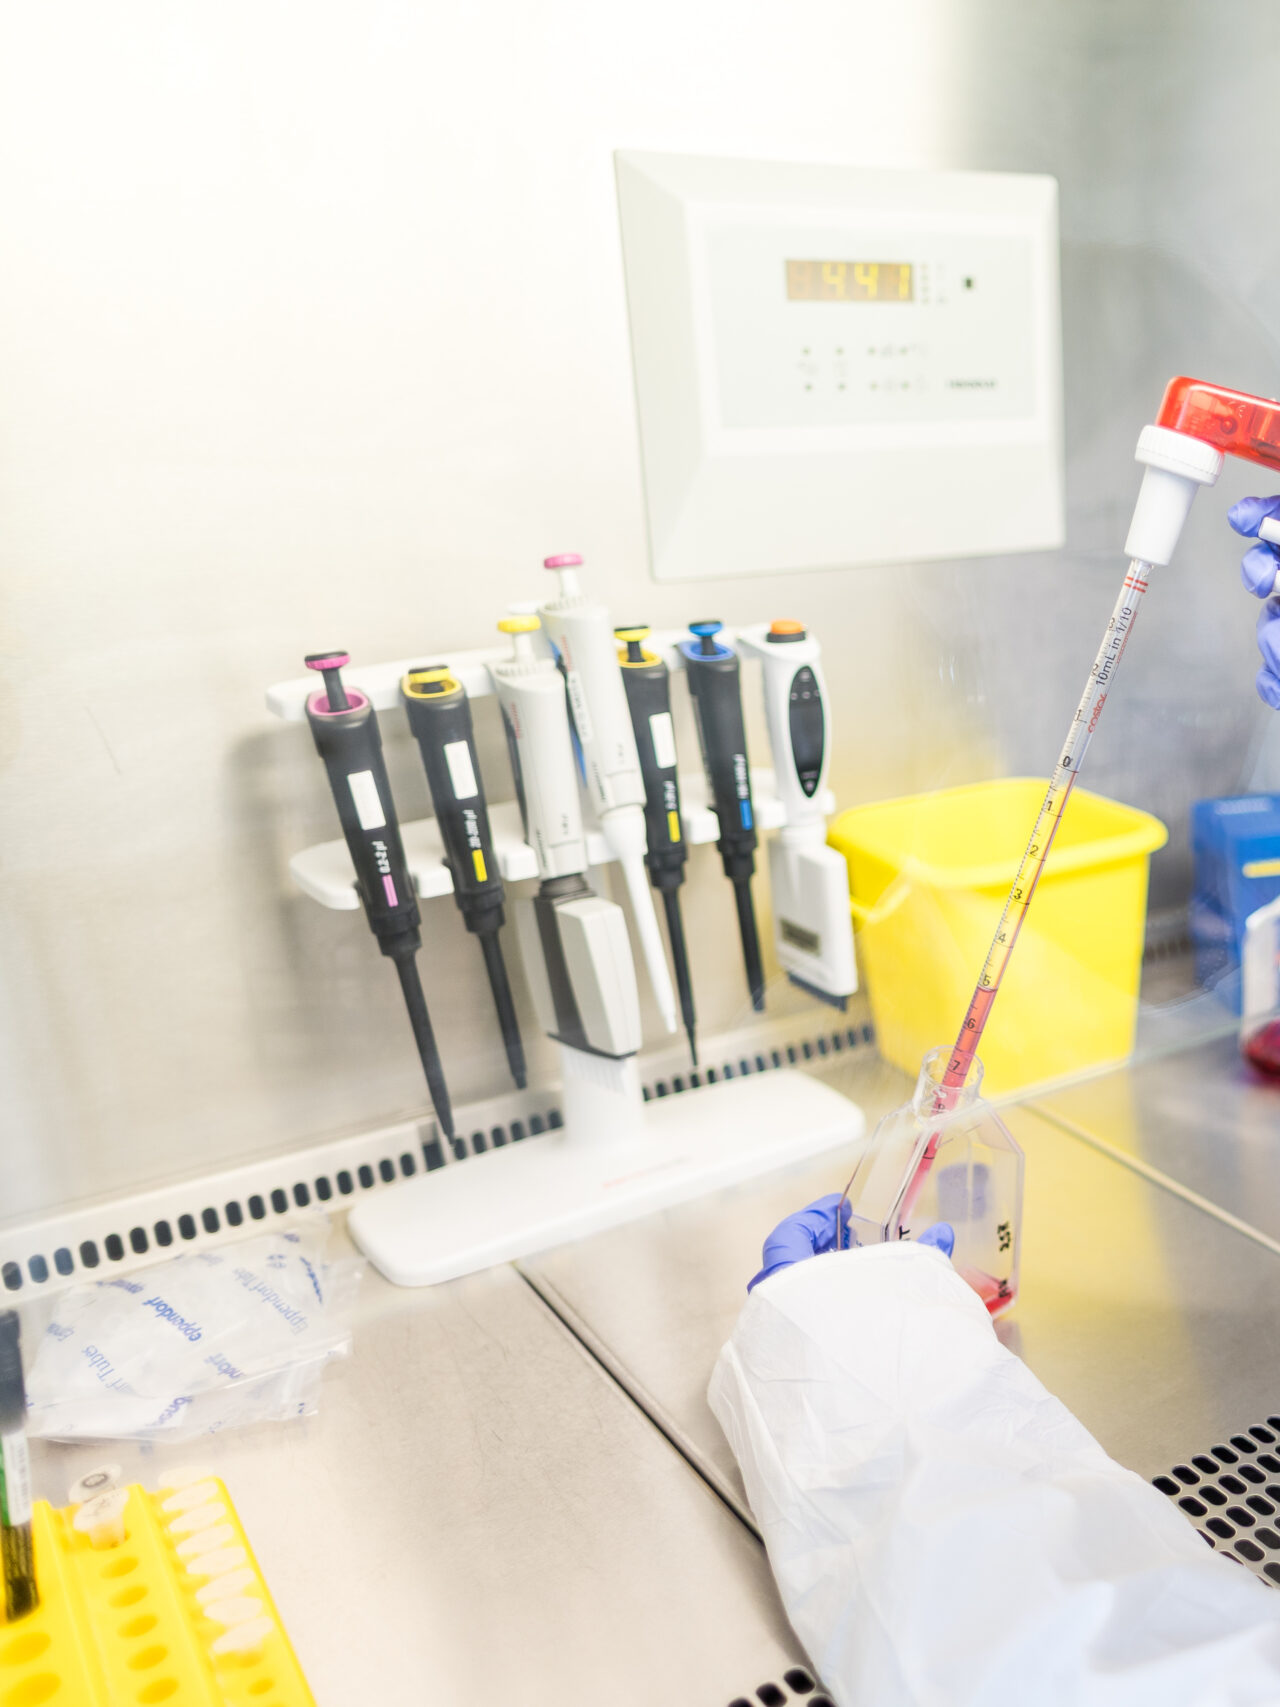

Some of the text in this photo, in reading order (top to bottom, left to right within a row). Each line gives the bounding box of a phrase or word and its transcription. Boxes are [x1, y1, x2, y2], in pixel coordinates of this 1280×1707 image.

[1095, 653, 1117, 686] 10mL
[1108, 637, 1121, 651] in
[1115, 606, 1133, 634] 1/10
[1062, 755, 1072, 768] 0
[1045, 800, 1053, 812] 1
[1029, 844, 1039, 857] 2
[1013, 888, 1023, 901] 3
[997, 933, 1007, 944] 4
[982, 974, 992, 987] 5
[966, 1017, 977, 1030] 6
[951, 1059, 961, 1072] 7
[142, 1296, 203, 1342] eppendorf
[81, 1343, 115, 1383] Tubes
